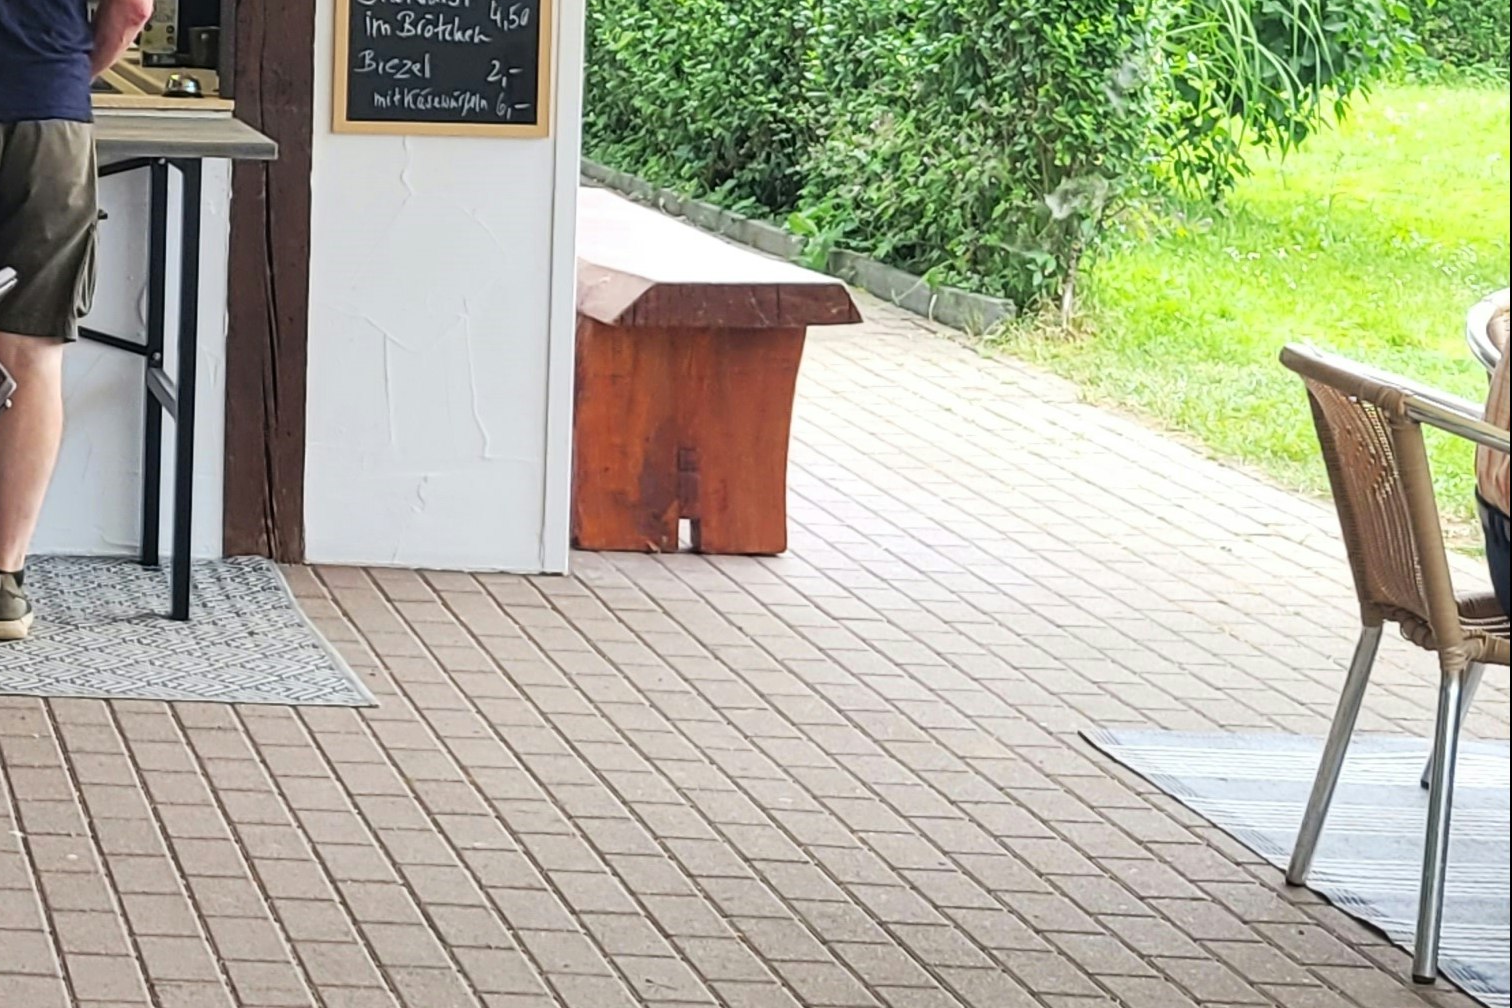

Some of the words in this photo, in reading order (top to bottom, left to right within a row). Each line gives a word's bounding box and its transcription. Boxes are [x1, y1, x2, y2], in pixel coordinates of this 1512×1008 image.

[365, 11, 391, 37] im
[396, 10, 493, 43] Brötchen
[489, 0, 529, 32] 4,50
[354, 49, 431, 79] Brezel
[374, 87, 401, 109] mit
